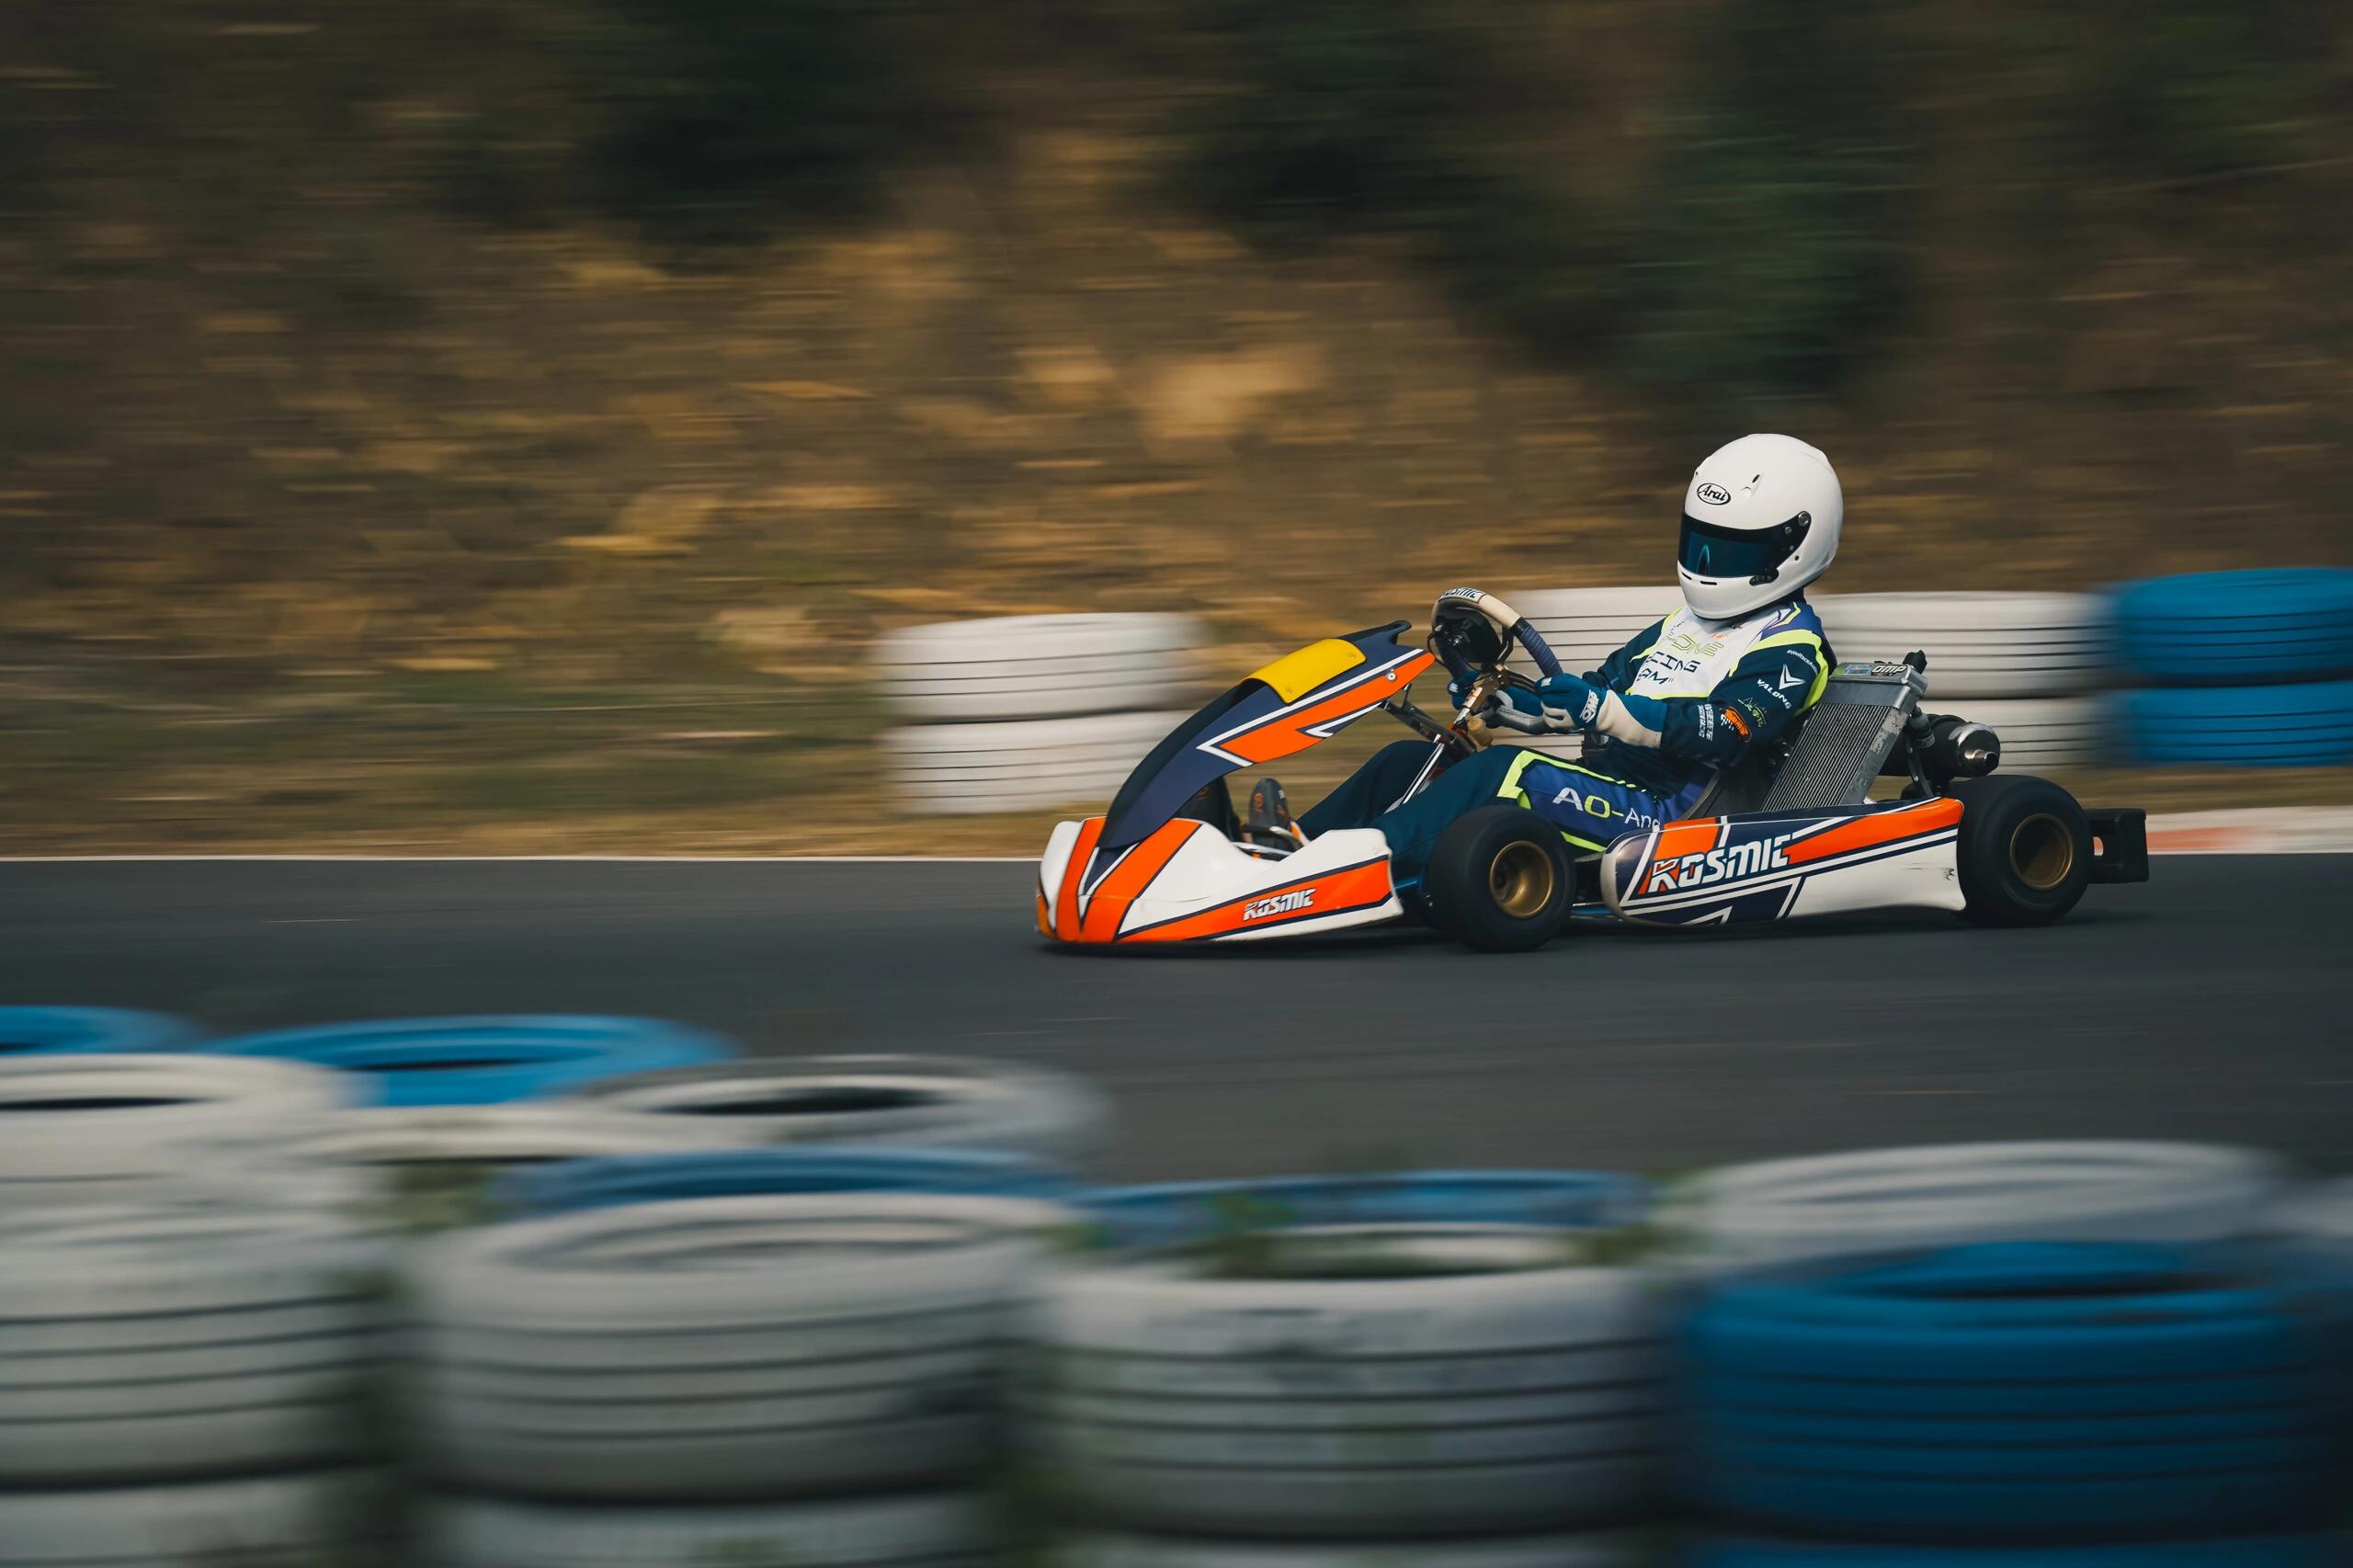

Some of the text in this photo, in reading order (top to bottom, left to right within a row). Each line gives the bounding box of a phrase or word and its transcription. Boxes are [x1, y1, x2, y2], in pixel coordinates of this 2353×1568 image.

[1699, 484, 1727, 501] Arai
[1647, 834, 1792, 893] KOSMIC
[1243, 888, 1316, 922] KOSMIC
